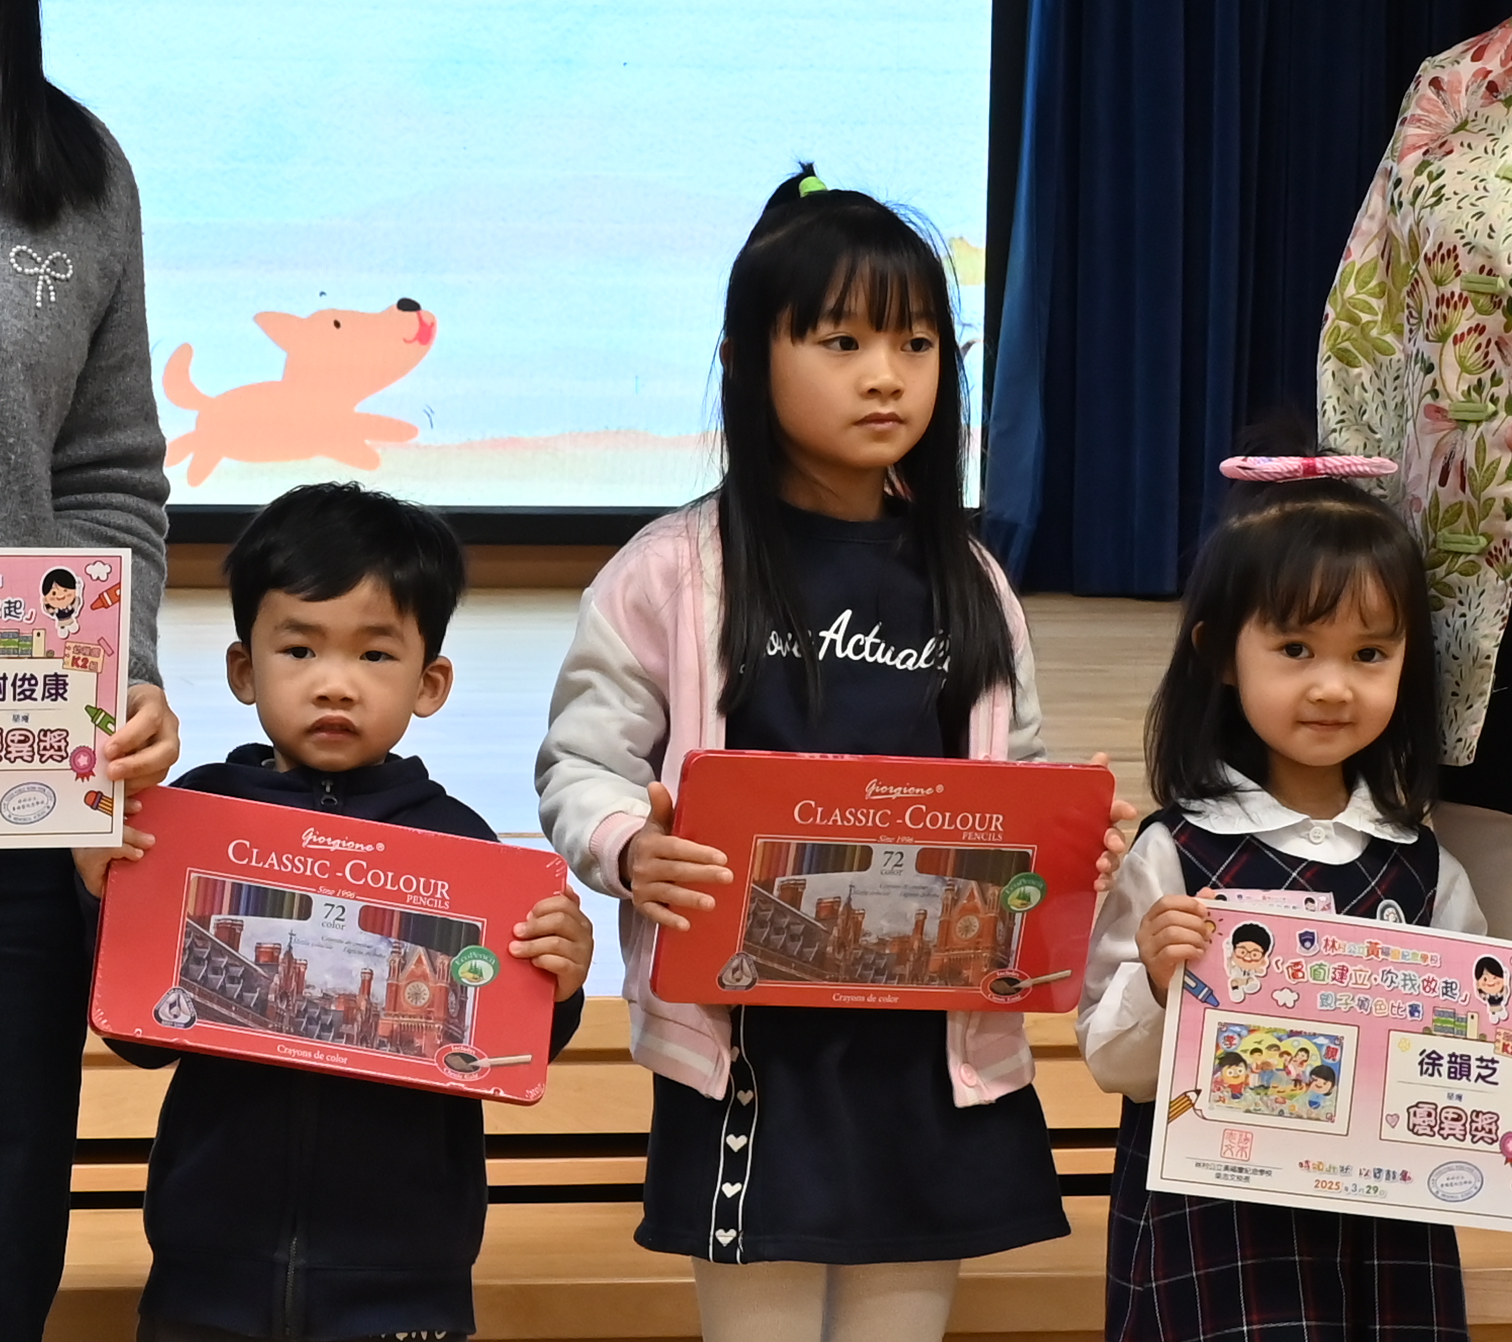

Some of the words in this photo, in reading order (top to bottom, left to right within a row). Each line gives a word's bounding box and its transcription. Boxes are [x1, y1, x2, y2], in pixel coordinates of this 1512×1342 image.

[793, 800, 891, 827] CLASSIC
[962, 832, 1003, 842] PENCILS
[227, 839, 331, 879] CLASSIC
[882, 850, 904, 867] 72
[880, 868, 904, 877] color
[406, 894, 451, 910] PENCILS
[323, 903, 346, 922] 72
[321, 919, 346, 931] color
[833, 992, 866, 1003] Crayons
[866, 993, 877, 1003] de
[878, 994, 900, 1004] color
[277, 1044, 313, 1059] Crayons
[314, 1050, 325, 1060] de
[326, 1053, 349, 1065] color
[1418, 1048, 1500, 1086] 徐韻芝
[1407, 1101, 1500, 1145] 優異獎
